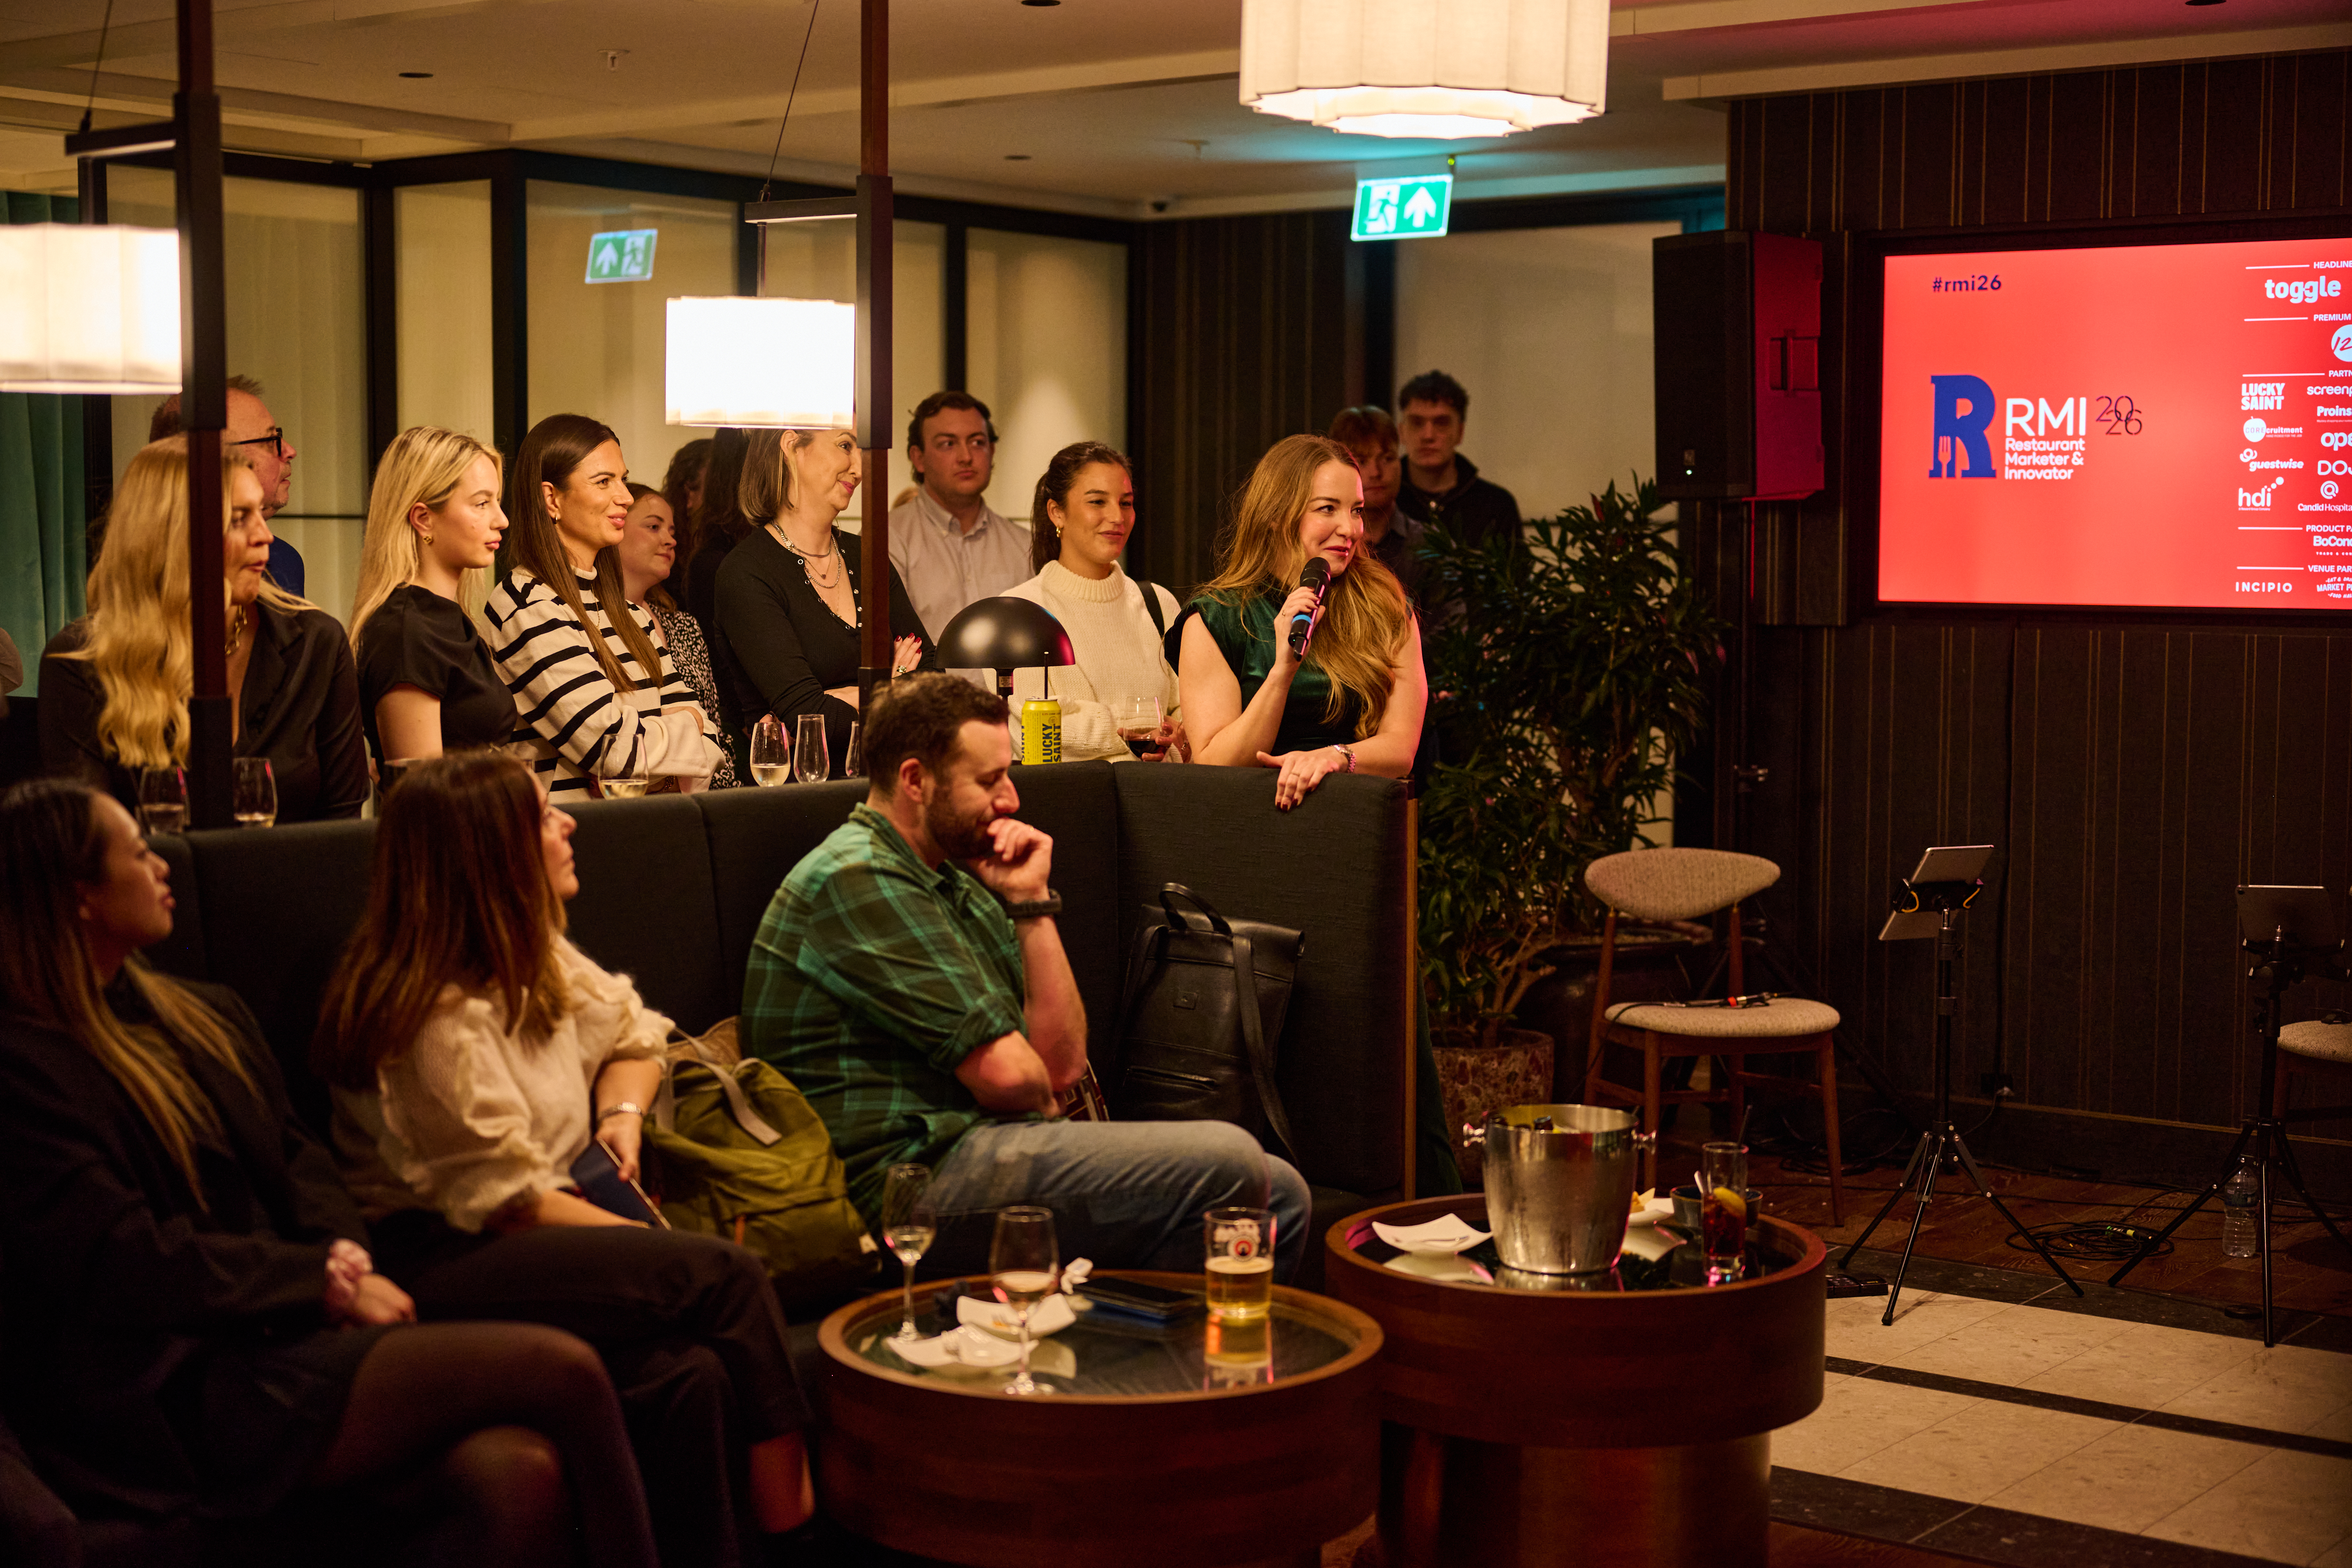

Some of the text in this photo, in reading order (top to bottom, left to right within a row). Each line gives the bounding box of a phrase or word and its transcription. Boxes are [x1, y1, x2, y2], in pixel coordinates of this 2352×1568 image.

[2313, 260, 2352, 269] HEADLINE
[1933, 275, 2002, 292] #rmi26
[2265, 275, 2341, 304] toggle
[2241, 383, 2285, 396] LUCKY
[2241, 396, 2284, 410] SAINT
[2006, 397, 2086, 436] RMI
[2317, 405, 2352, 416] Proins
[2005, 438, 2085, 451] Restaurant
[2005, 452, 2084, 466] Marketer &
[2249, 458, 2304, 472] guestwise
[2004, 467, 2073, 480] Innovator
[2238, 487, 2272, 507] hdi
[2236, 582, 2292, 593] INCIPIO
[2317, 583, 2345, 592] MARKET
[1043, 724, 1052, 762] LUCKY
